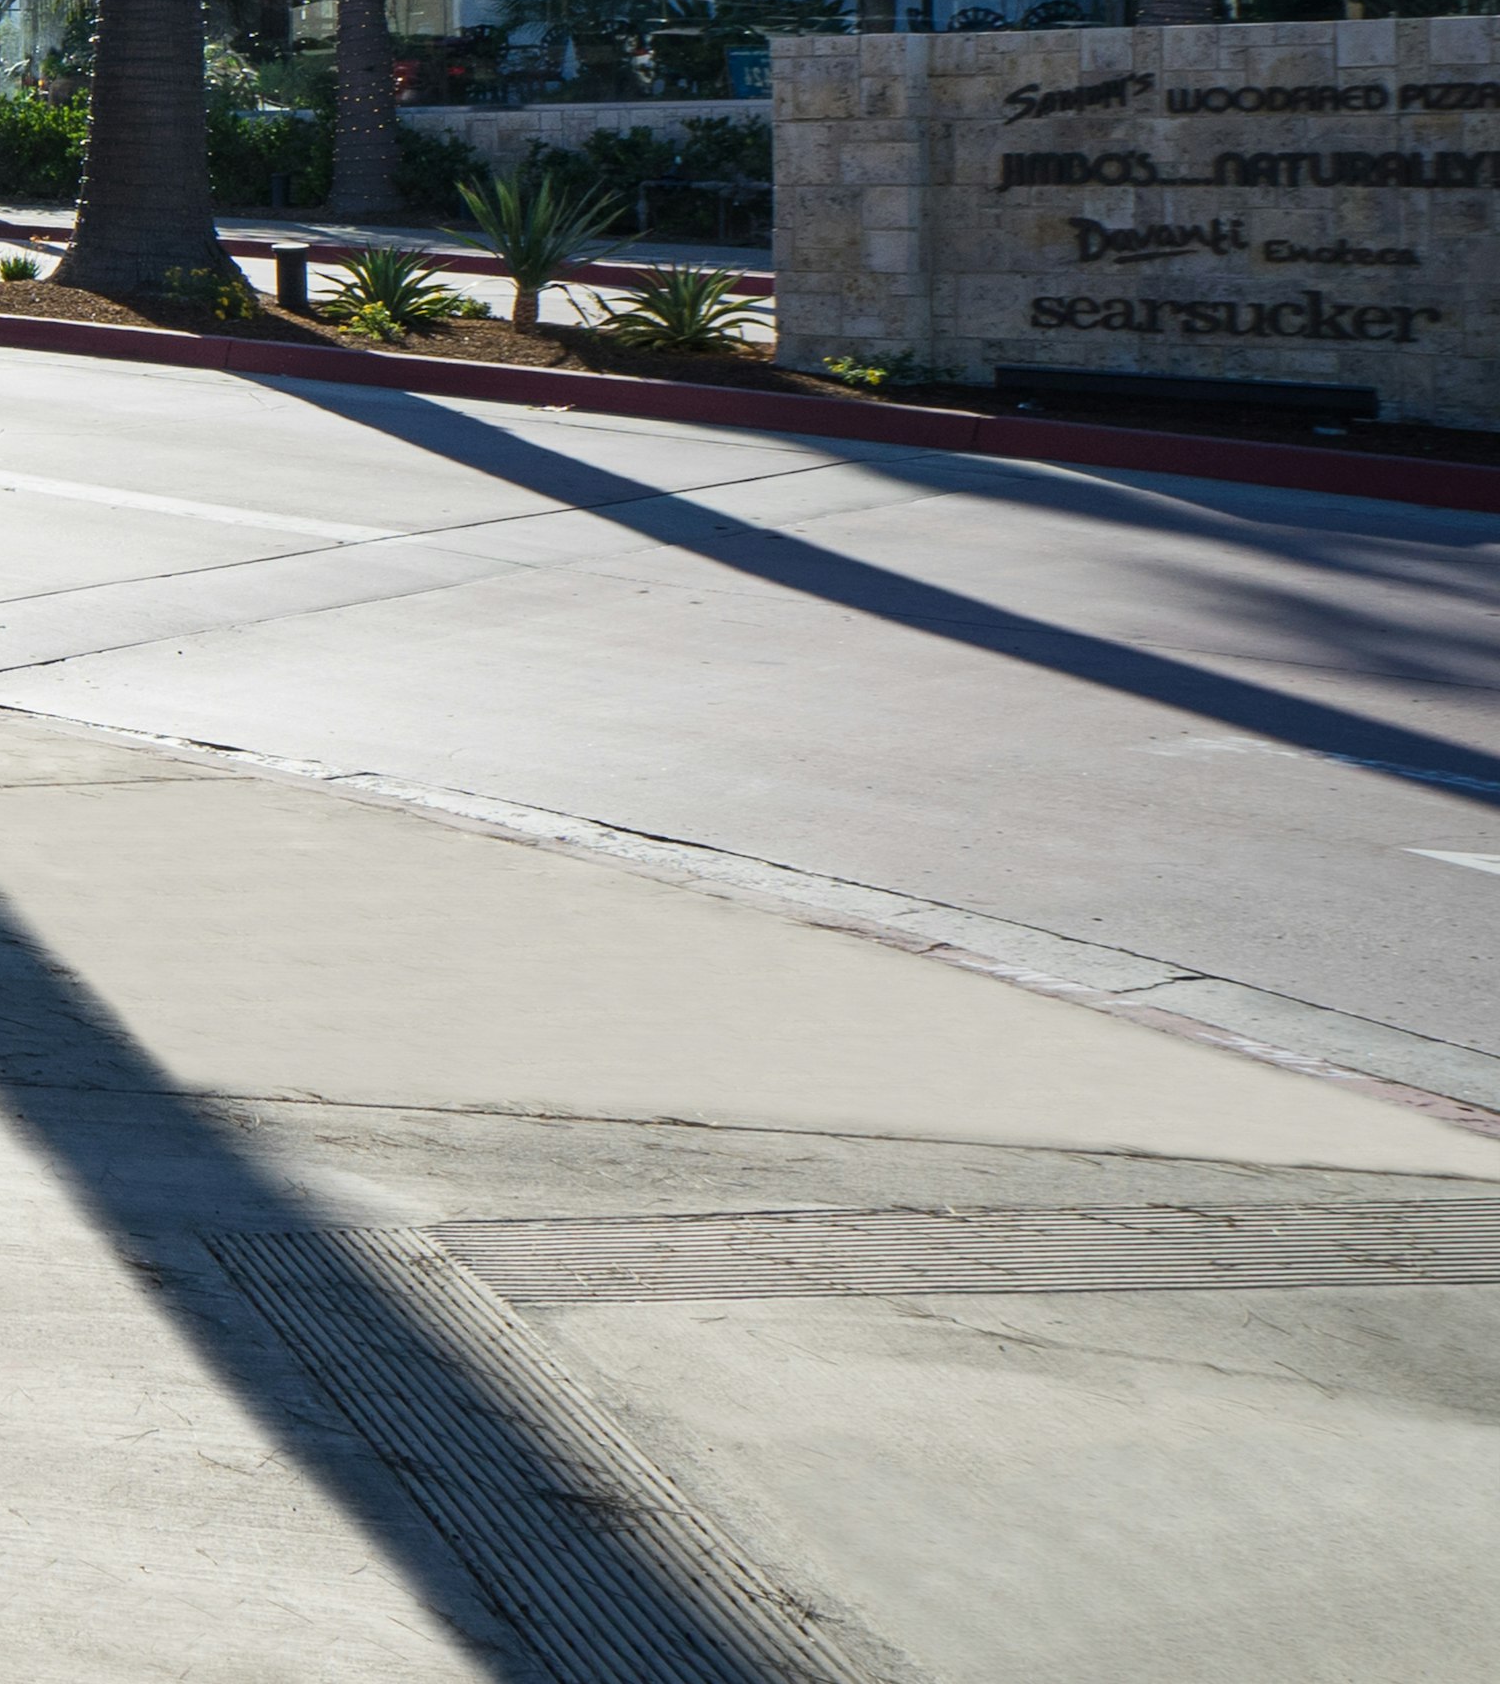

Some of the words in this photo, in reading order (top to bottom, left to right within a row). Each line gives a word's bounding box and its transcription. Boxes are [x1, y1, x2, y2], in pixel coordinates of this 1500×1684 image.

[1166, 84, 1389, 114] WOODFIRED
[1400, 81, 1500, 110] PIZZA
[1068, 216, 1248, 264] Davanti
[1264, 239, 1423, 266] Enoteca
[1031, 290, 1443, 344] searsucker
